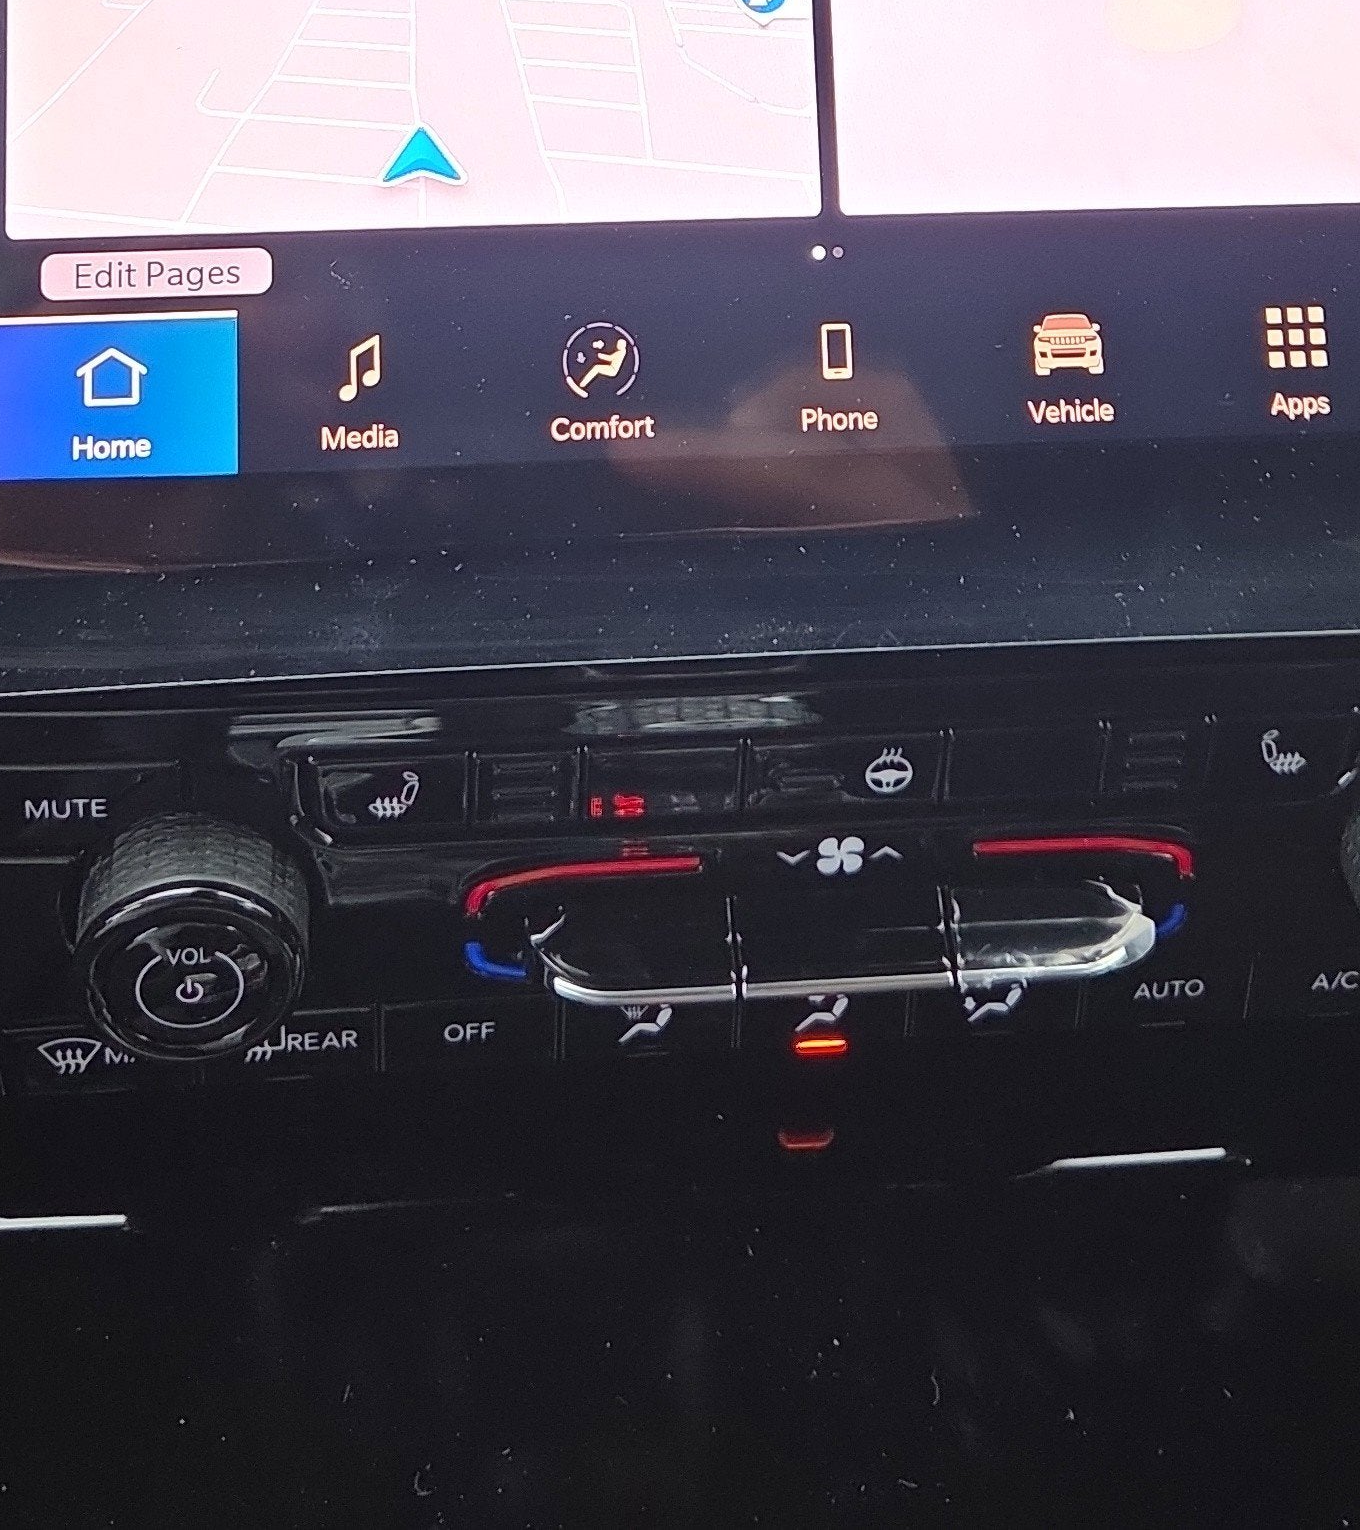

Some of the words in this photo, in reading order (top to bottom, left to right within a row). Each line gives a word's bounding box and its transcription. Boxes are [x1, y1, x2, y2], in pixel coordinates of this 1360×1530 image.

[74, 262, 138, 291] Edit
[147, 260, 241, 294] Pages
[800, 406, 880, 435] Phone
[1026, 397, 1116, 425] Vehicle
[1269, 391, 1332, 422] Apps
[320, 423, 400, 452] Media
[549, 414, 657, 444] Comfort
[71, 434, 153, 462] Home
[23, 797, 109, 820] MUTE
[165, 945, 213, 967] VOL
[1132, 977, 1207, 1001] AUTO
[1310, 969, 1360, 992] A/C
[285, 1028, 359, 1052] REAR
[442, 1020, 497, 1043] OFF
